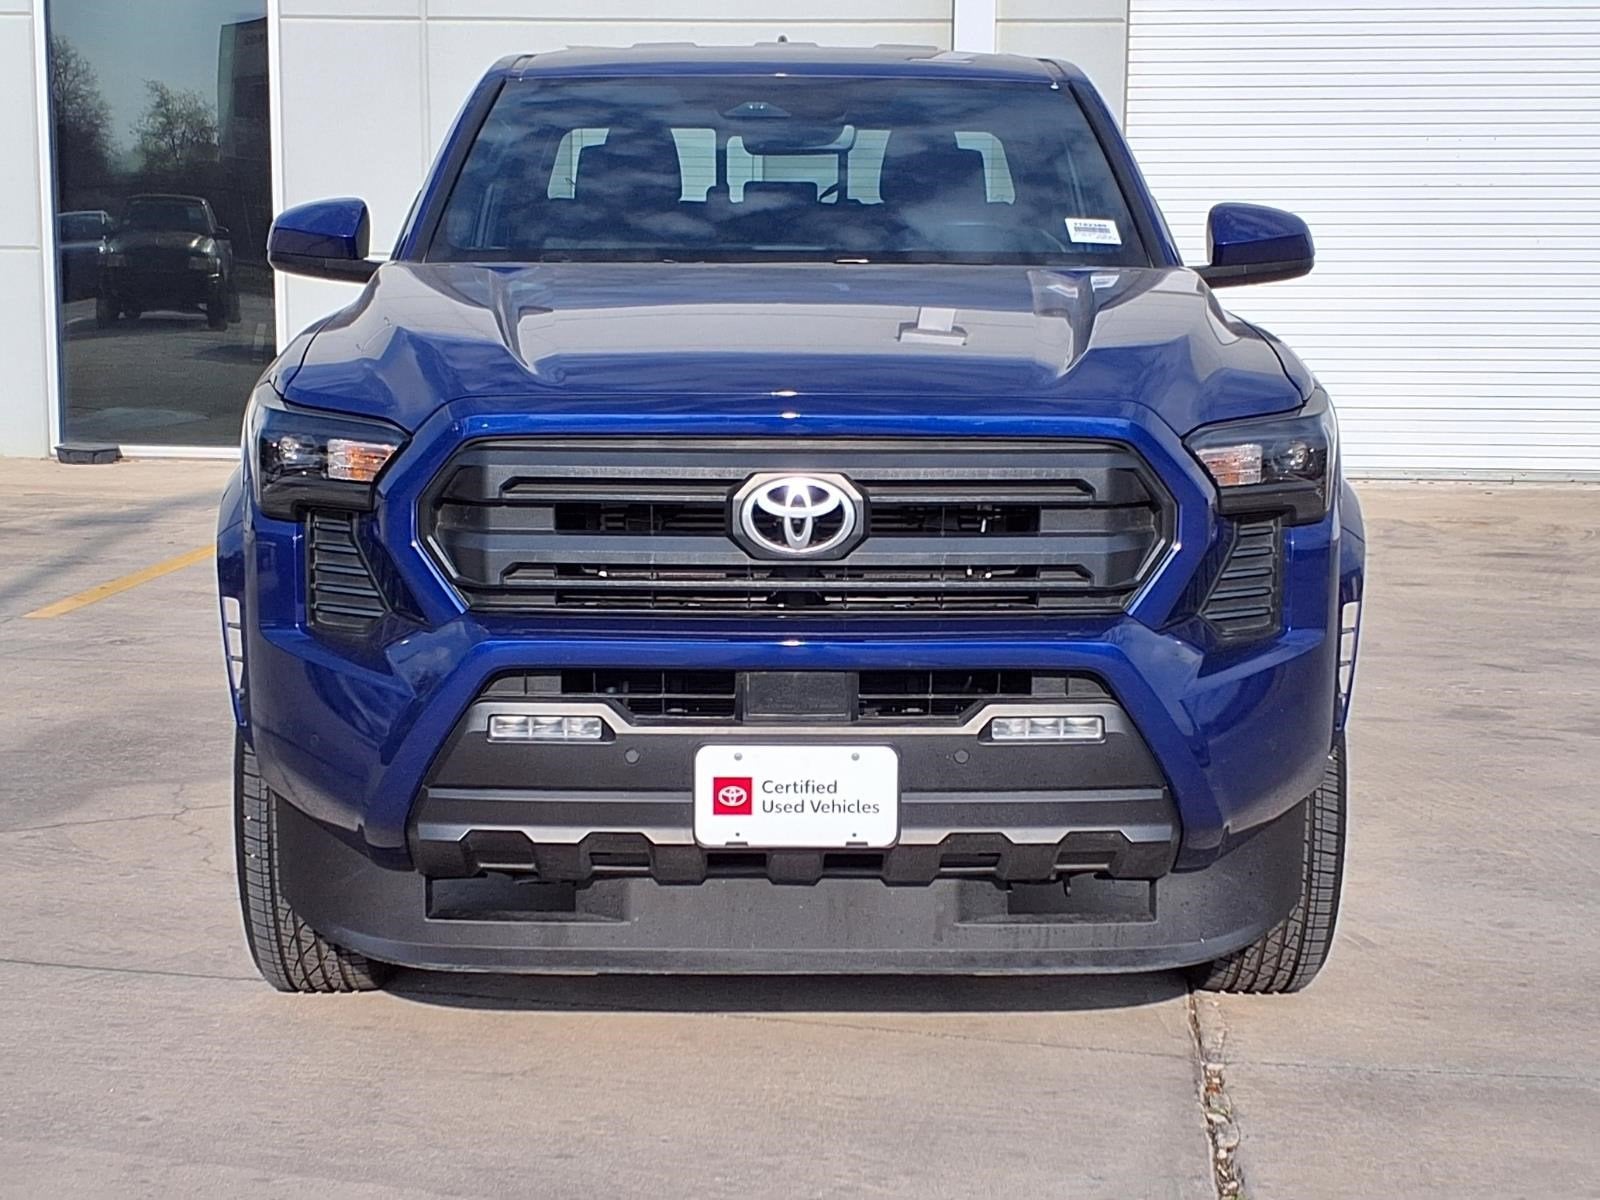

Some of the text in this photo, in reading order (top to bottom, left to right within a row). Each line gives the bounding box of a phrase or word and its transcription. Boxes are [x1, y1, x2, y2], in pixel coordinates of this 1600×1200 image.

[761, 779, 838, 794] Certified
[761, 799, 880, 814] Used Vehicles
